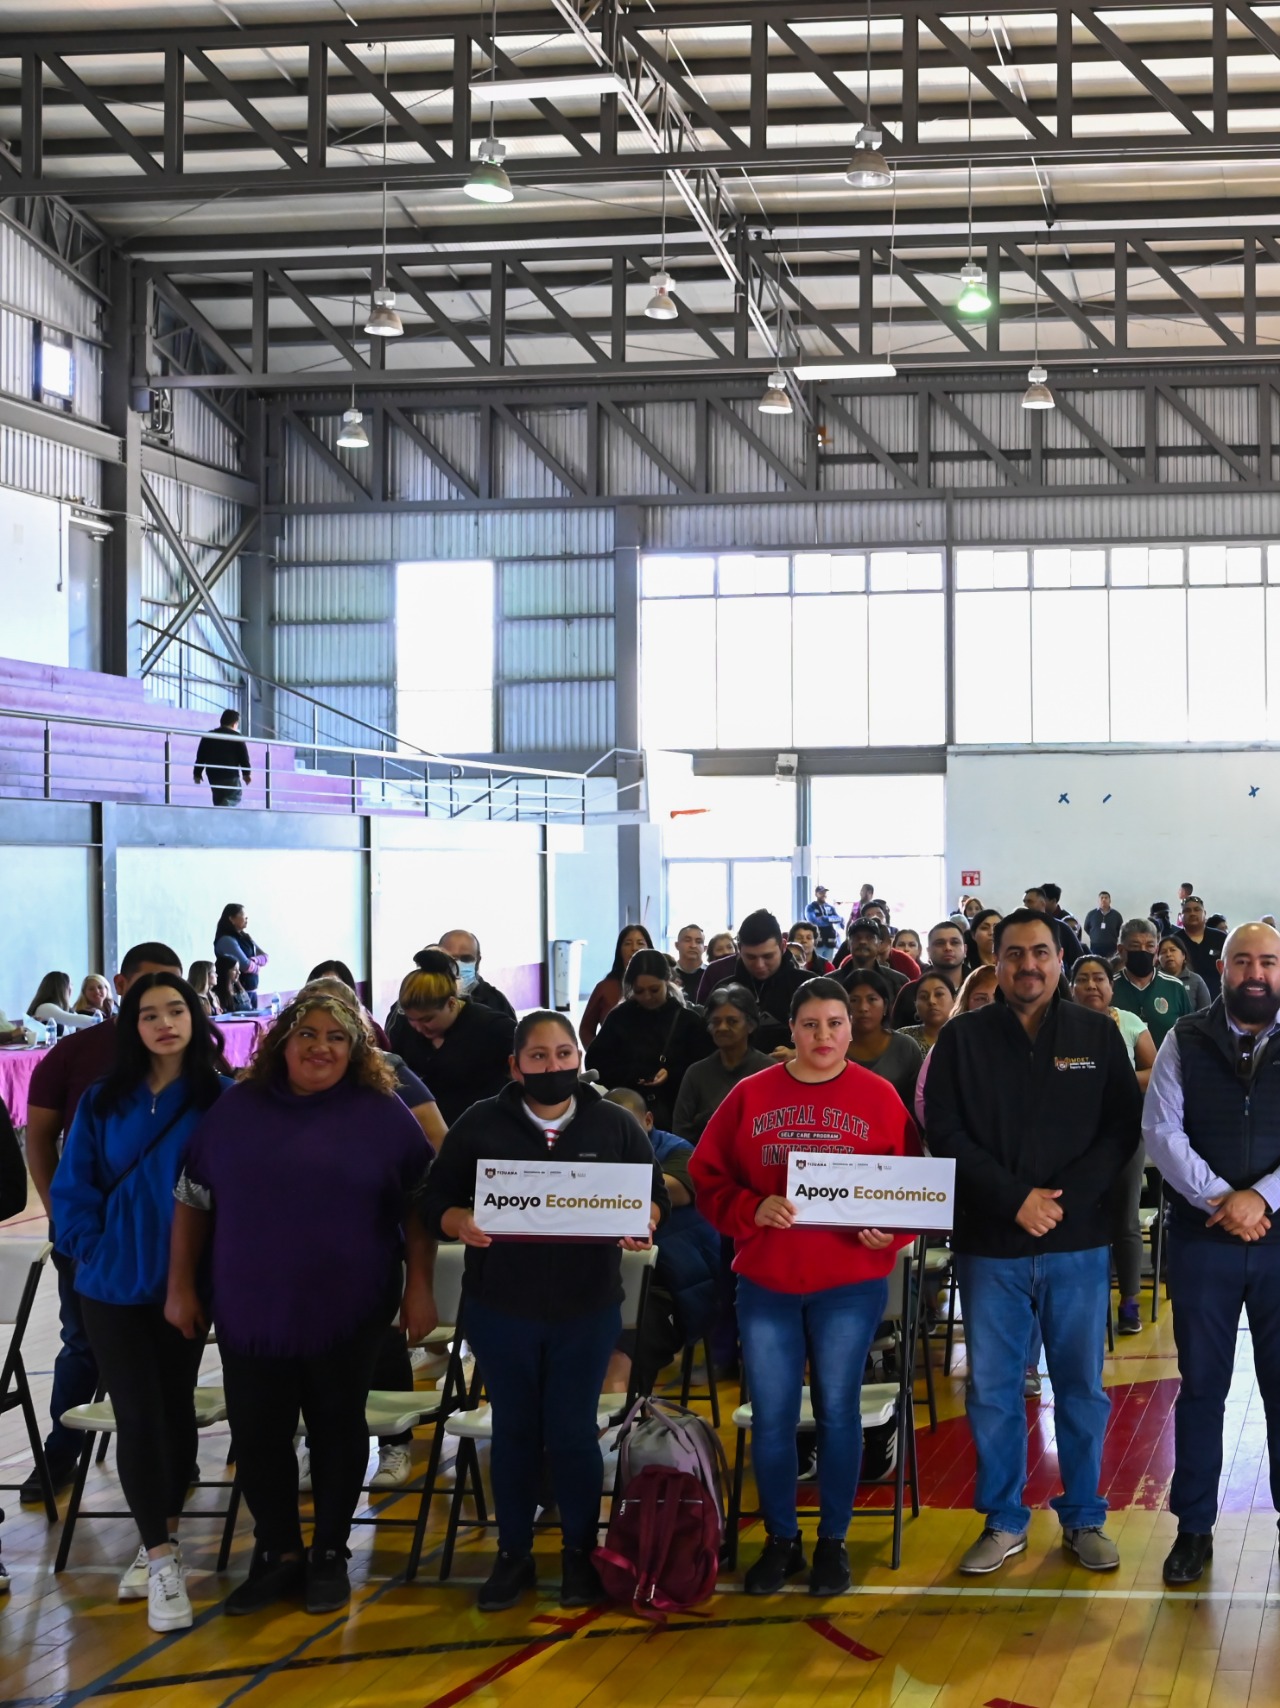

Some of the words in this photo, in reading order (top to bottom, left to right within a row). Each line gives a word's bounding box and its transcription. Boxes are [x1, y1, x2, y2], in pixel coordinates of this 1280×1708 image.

[752, 1105, 816, 1138] MENTAL
[822, 1107, 870, 1141] STATE
[483, 1193, 541, 1210] Apoyo
[545, 1194, 643, 1210] Económico
[795, 1184, 849, 1201] Apoyo
[853, 1186, 947, 1202] Económico
